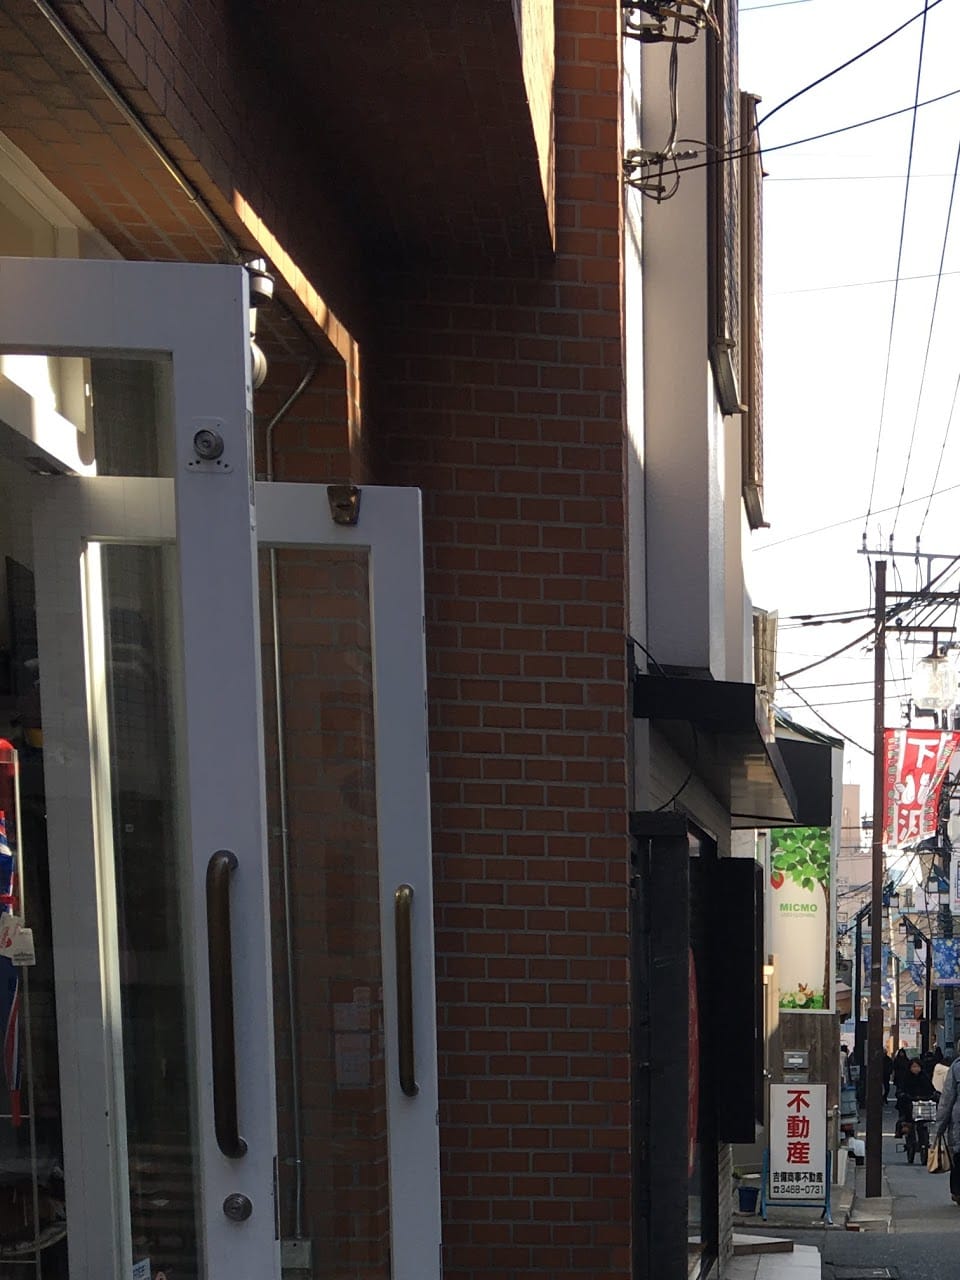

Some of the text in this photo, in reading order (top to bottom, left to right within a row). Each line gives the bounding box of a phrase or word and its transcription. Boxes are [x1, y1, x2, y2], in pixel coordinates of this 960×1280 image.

[779, 903, 818, 912] MICMO
[787, 1090, 810, 1164] 不動産
